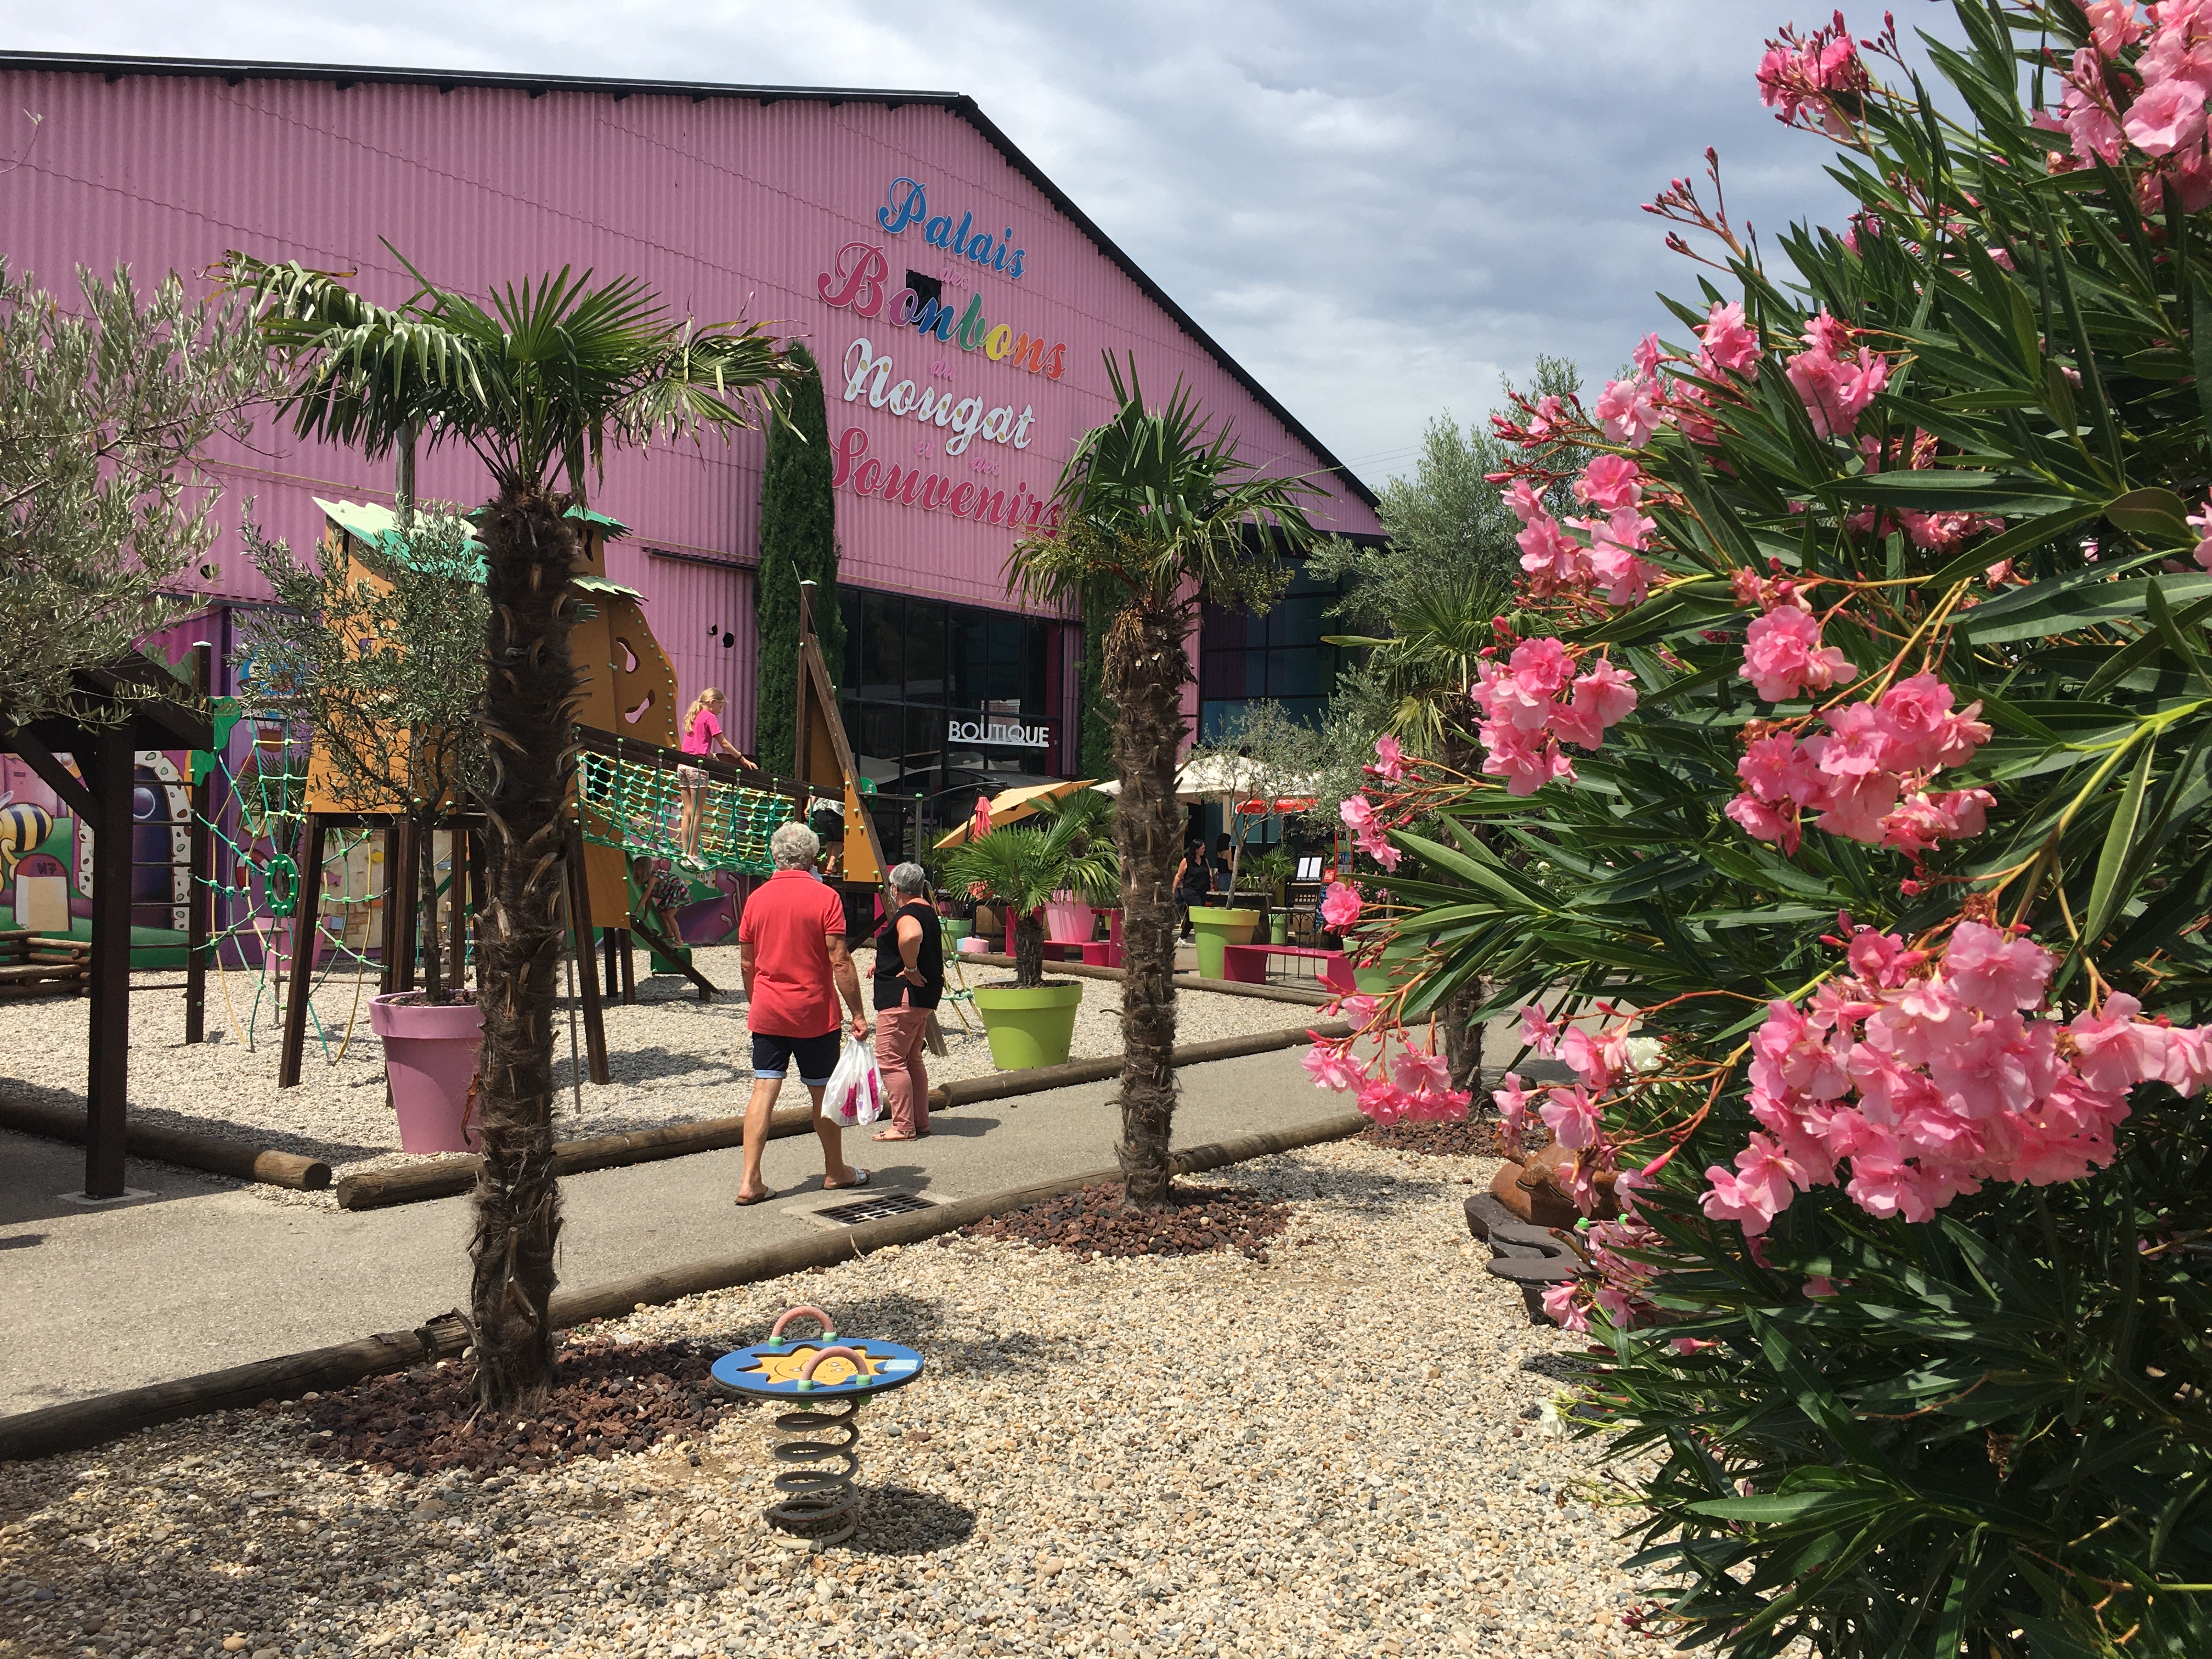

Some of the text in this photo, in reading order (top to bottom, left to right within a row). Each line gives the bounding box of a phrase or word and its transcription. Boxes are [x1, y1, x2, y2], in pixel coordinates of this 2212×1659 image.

[878, 177, 1026, 279] Palais
[817, 241, 1066, 380] Bonbons
[940, 264, 969, 289] des
[844, 337, 1035, 456] Nougat
[930, 356, 957, 381] du
[828, 426, 1063, 538] Souvenirs
[915, 440, 1000, 476] et des
[949, 720, 1049, 746] BOUTIQUE
